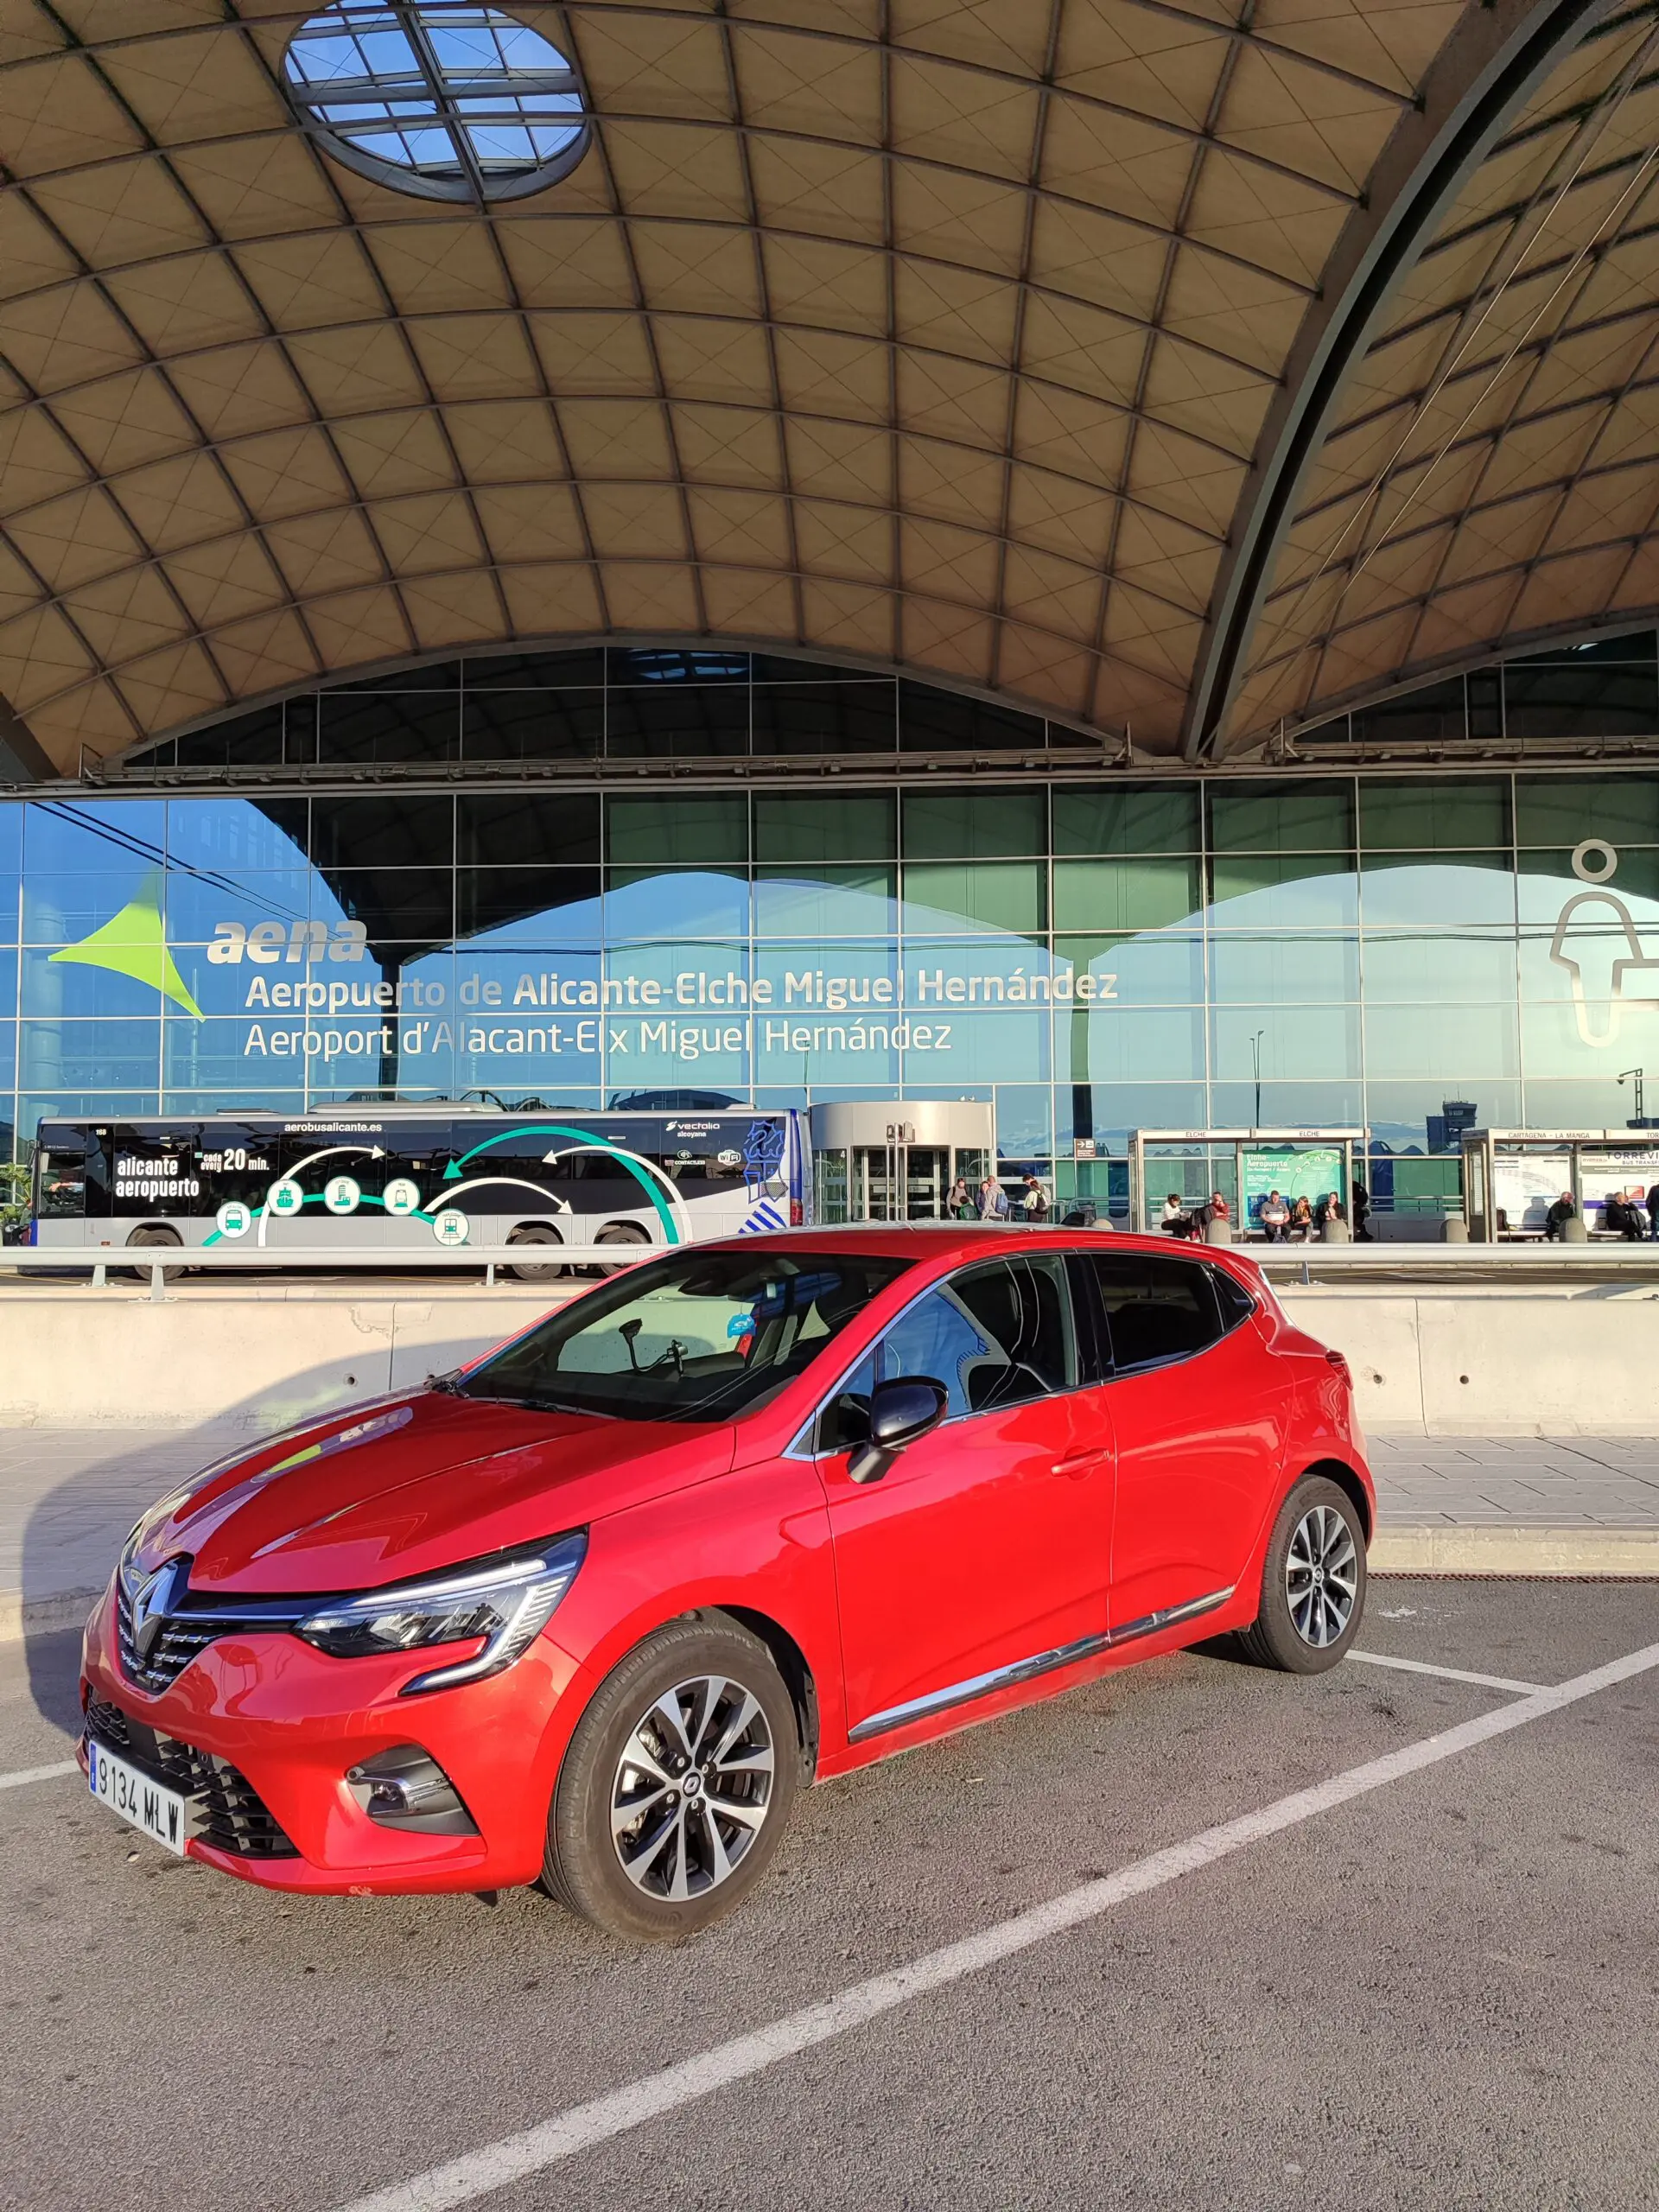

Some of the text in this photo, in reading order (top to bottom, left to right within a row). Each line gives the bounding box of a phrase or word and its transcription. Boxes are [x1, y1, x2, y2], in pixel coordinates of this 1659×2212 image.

[207, 920, 367, 964] aena
[245, 968, 1117, 1014] Aeropuerto de Alicante-Elche Miguel Hernández
[244, 1024, 392, 1062] Aeroport
[640, 1020, 751, 1060] Miguel
[766, 1018, 952, 1052] Hernández
[284, 1122, 383, 1132] aerobusalicante.es
[118, 1156, 178, 1176] alicante
[200, 1161, 222, 1173] every
[203, 1153, 222, 1162] cada
[224, 1148, 270, 1170] 20 min.
[116, 1179, 200, 1203] aeropuerto
[99, 1758, 179, 1845] 9134 MLW
